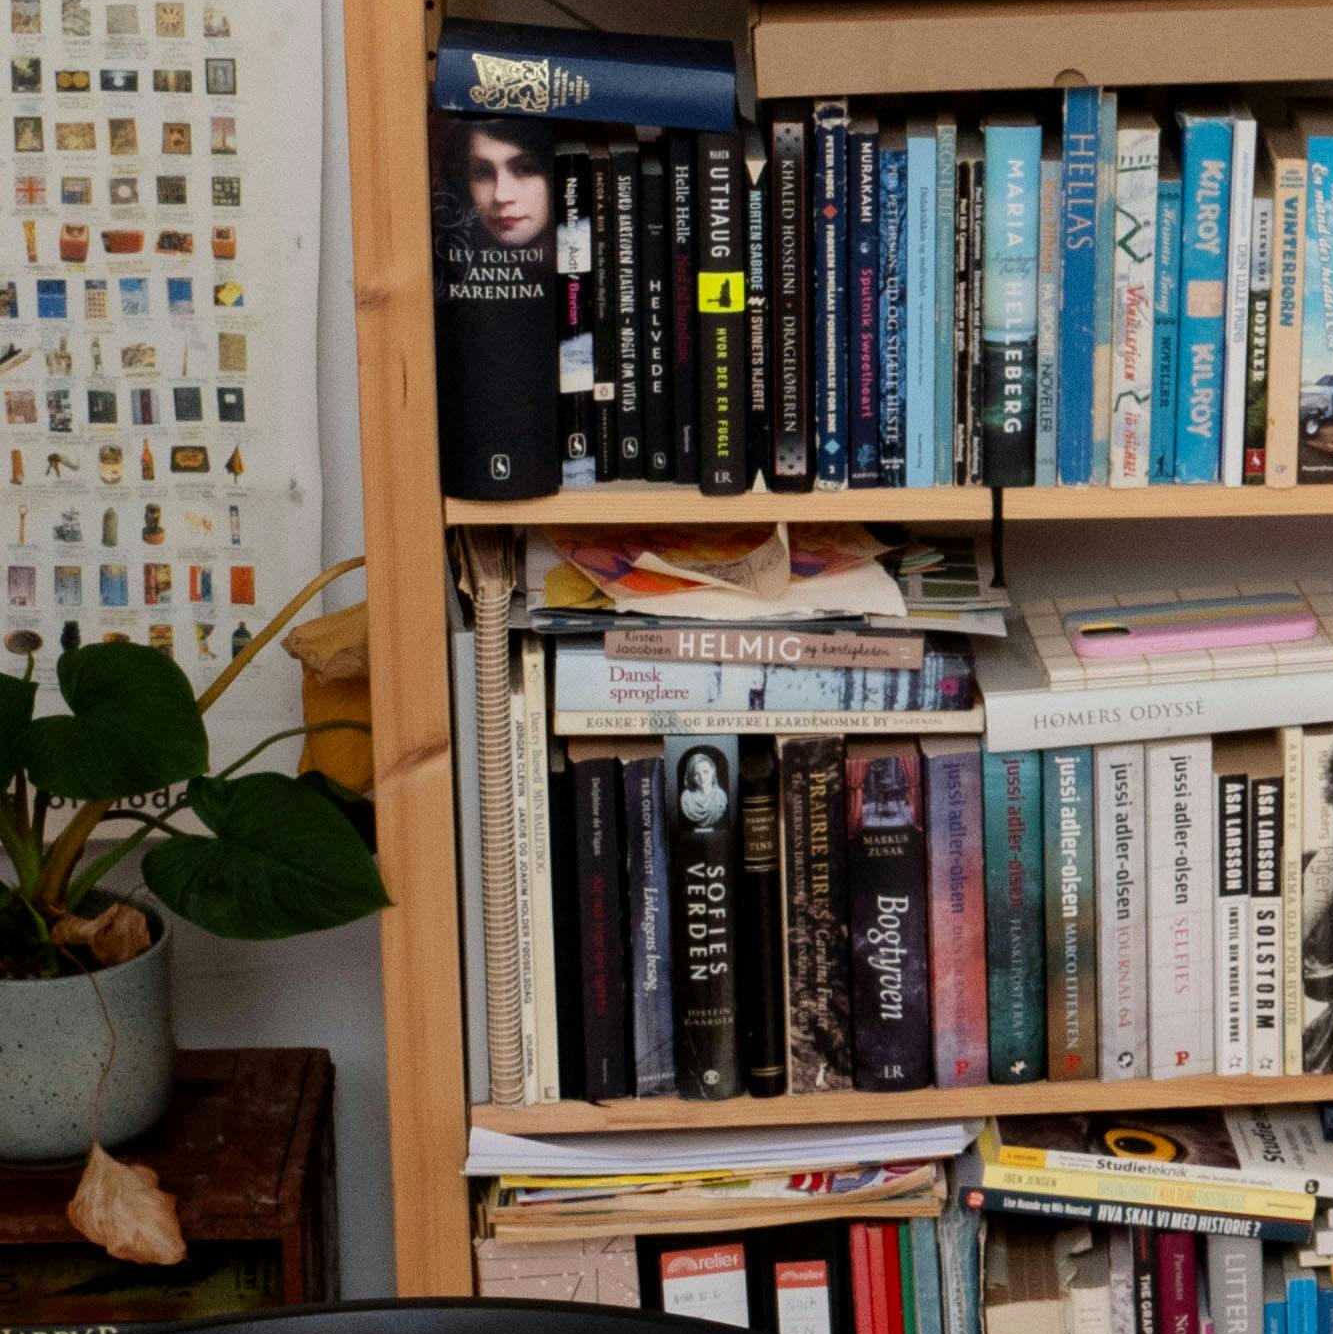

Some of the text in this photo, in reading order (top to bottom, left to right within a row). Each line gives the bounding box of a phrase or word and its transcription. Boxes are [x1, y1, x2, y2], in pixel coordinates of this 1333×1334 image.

[675, 165, 690, 243] Helle Helle
[860, 143, 873, 222] MURAKAMI
[1067, 134, 1096, 250] HELLAS
[449, 249, 478, 263] LEV
[450, 284, 544, 299] KARENINA
[469, 268, 523, 281] ANNA
[782, 160, 797, 432] KHALED HOSSEINI DRAGELØBEREN
[825, 135, 837, 432] PETER FOR SNE
[886, 277, 898, 299] UD
[1003, 158, 1025, 433] MARIA HELLEBERG
[1279, 197, 1298, 327] VINTERBØRN
[710, 167, 730, 457] UTHAUG HVOR DER ER FUGLE
[749, 190, 765, 411] MORTEN SVINETS HJERTE
[1188, 159, 1225, 437] KILROY KILROY
[1251, 299, 1268, 381] DOPPLER
[886, 395, 900, 443] HESTE
[1040, 363, 1053, 432] NOVELLER
[610, 665, 662, 683] Dansk
[678, 632, 801, 662] HELMIG
[609, 684, 689, 703] sproglære
[640, 716, 676, 729] FOLK
[684, 717, 702, 728] OG
[1033, 707, 1121, 730] HOMERS
[643, 831, 653, 875] ENQUIST
[809, 772, 828, 856] PRAIRIE
[1002, 760, 1025, 907] jussi adler-olsen
[1110, 763, 1135, 920] jussi adler-olsen
[1225, 818, 1242, 890] LARSSON
[518, 807, 530, 938] JAKOB OG JOAKIM HOLDER
[1054, 756, 1082, 973] jussi adler-olsen MARCO
[1169, 755, 1191, 993] jussi adler-olsen SELFIES
[686, 862, 707, 980] VERDEN
[707, 866, 727, 975] SOFIES
[1256, 785, 1277, 1029] ÅSA LARSSON SOLSTORM
[868, 895, 910, 1020] Bogtyven
[1097, 1157, 1187, 1179] Studieteknik
[1124, 1208, 1251, 1234] SKAL VI MED HISTORIE
[698, 1253, 738, 1270] relief
[1140, 1274, 1152, 1299] THE
